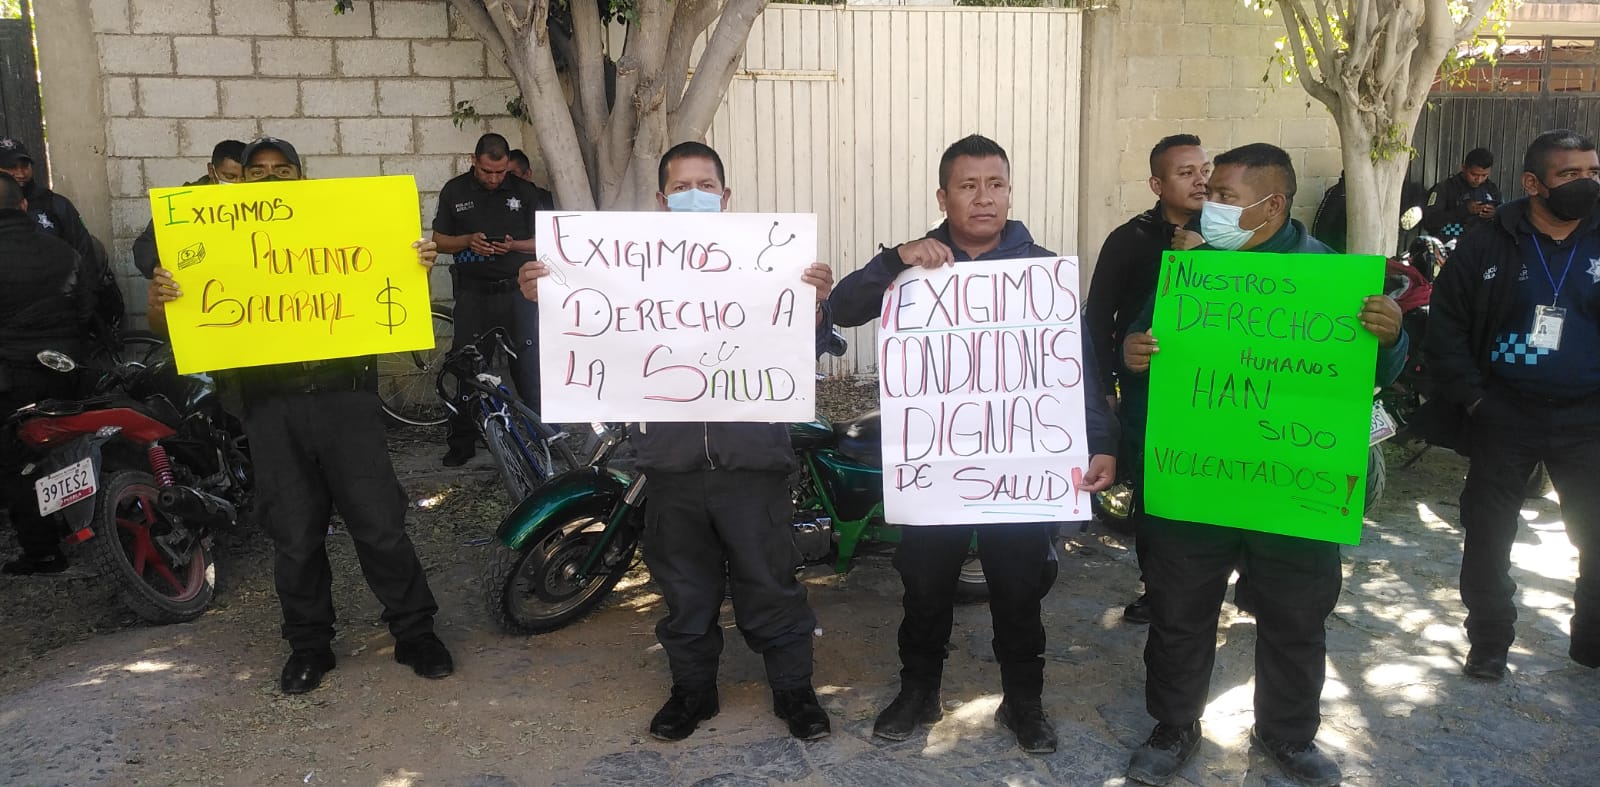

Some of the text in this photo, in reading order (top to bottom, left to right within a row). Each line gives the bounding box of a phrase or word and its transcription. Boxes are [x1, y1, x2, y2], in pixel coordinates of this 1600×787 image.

[158, 191, 294, 231] EXIGIMOS
[251, 231, 373, 275] AUMENTO
[1162, 255, 1297, 297] ¡NUESTROS
[196, 279, 355, 335] SALARIAL
[561, 287, 795, 337] DERECHO A
[881, 259, 1078, 333] ¡EXIGIMOS
[1175, 293, 1358, 343] DERECHOS
[565, 350, 605, 400] LA
[881, 328, 1081, 398] CONDICIONES
[1240, 347, 1338, 378] HUMANOS
[1192, 367, 1271, 410] HAN
[903, 394, 1073, 462] DIGNAS
[1258, 420, 1337, 449] SIDO
[42, 470, 89, 503] 39TES2
[895, 464, 1084, 514] DE SALUD!
[1154, 447, 1359, 516] VIOLENTADOS!
